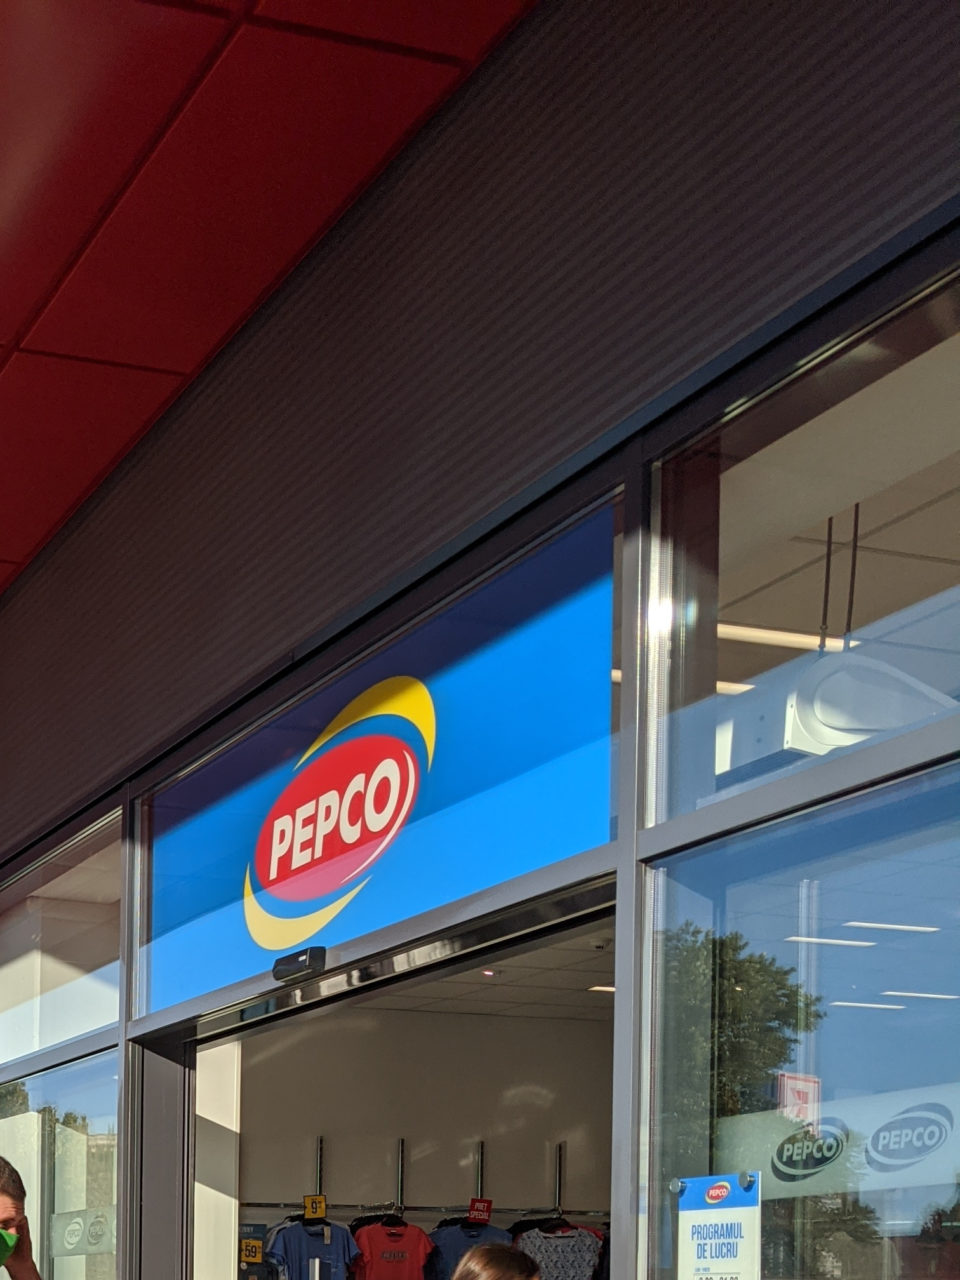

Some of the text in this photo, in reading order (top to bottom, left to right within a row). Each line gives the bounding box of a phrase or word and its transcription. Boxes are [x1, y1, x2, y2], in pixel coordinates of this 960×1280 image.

[269, 758, 400, 881] PEPCO
[878, 1125, 940, 1151] PEPCO
[782, 1137, 838, 1162] PEPCO
[709, 1188, 727, 1198] PEPCO
[691, 1222, 744, 1241] PROGRAMUL
[697, 1241, 738, 1260] DE LUCRU
